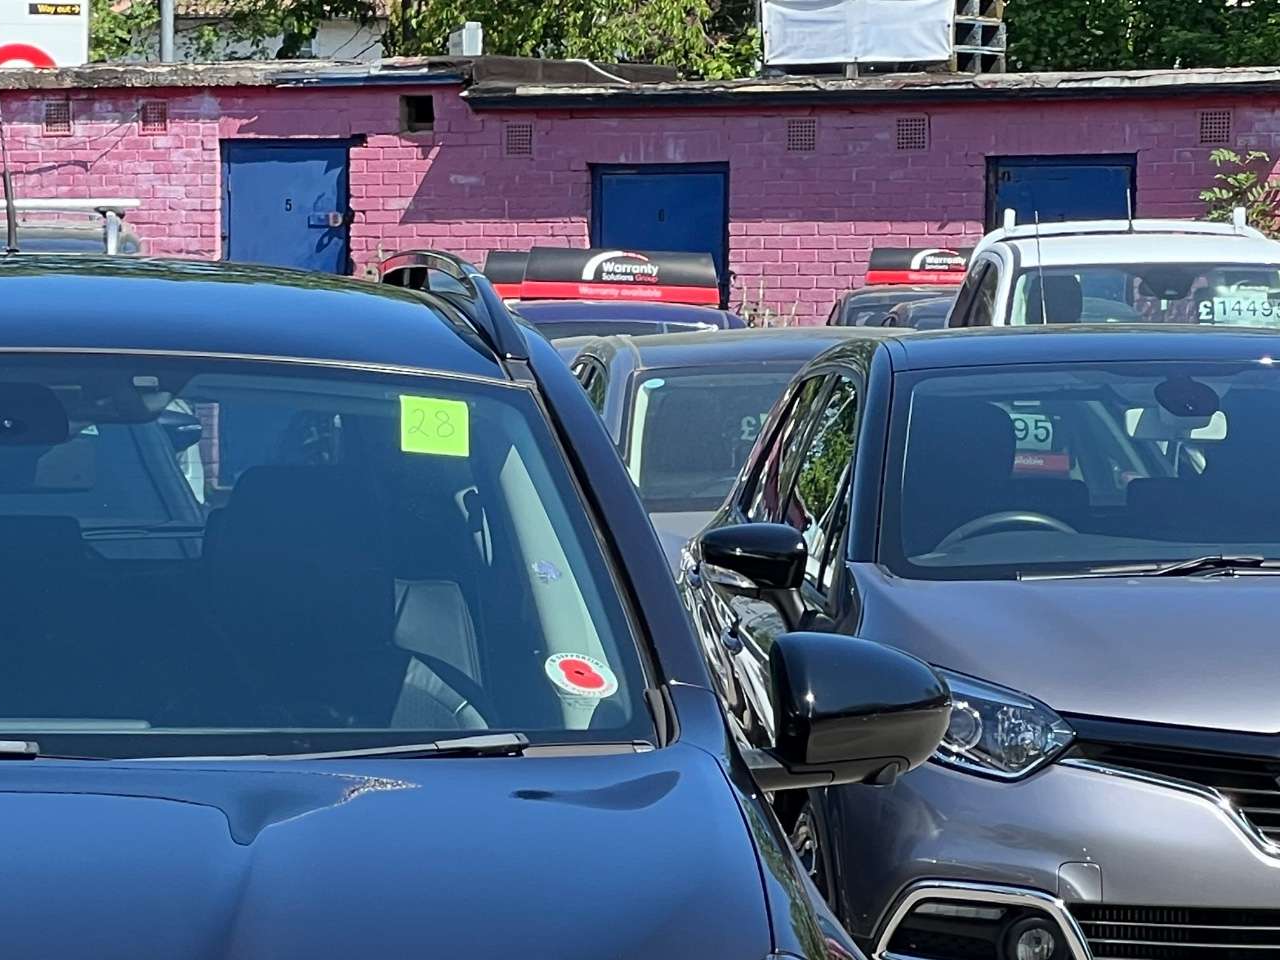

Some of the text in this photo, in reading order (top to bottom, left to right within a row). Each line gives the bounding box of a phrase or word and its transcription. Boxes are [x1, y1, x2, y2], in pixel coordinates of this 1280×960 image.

[37, 4, 72, 14] Way out
[285, 199, 293, 211] 5
[602, 262, 659, 277] Warranty
[602, 273, 658, 283] Solutions Group
[579, 287, 619, 298] Warranty
[408, 408, 455, 438] 28
[1012, 418, 1050, 443] 95
